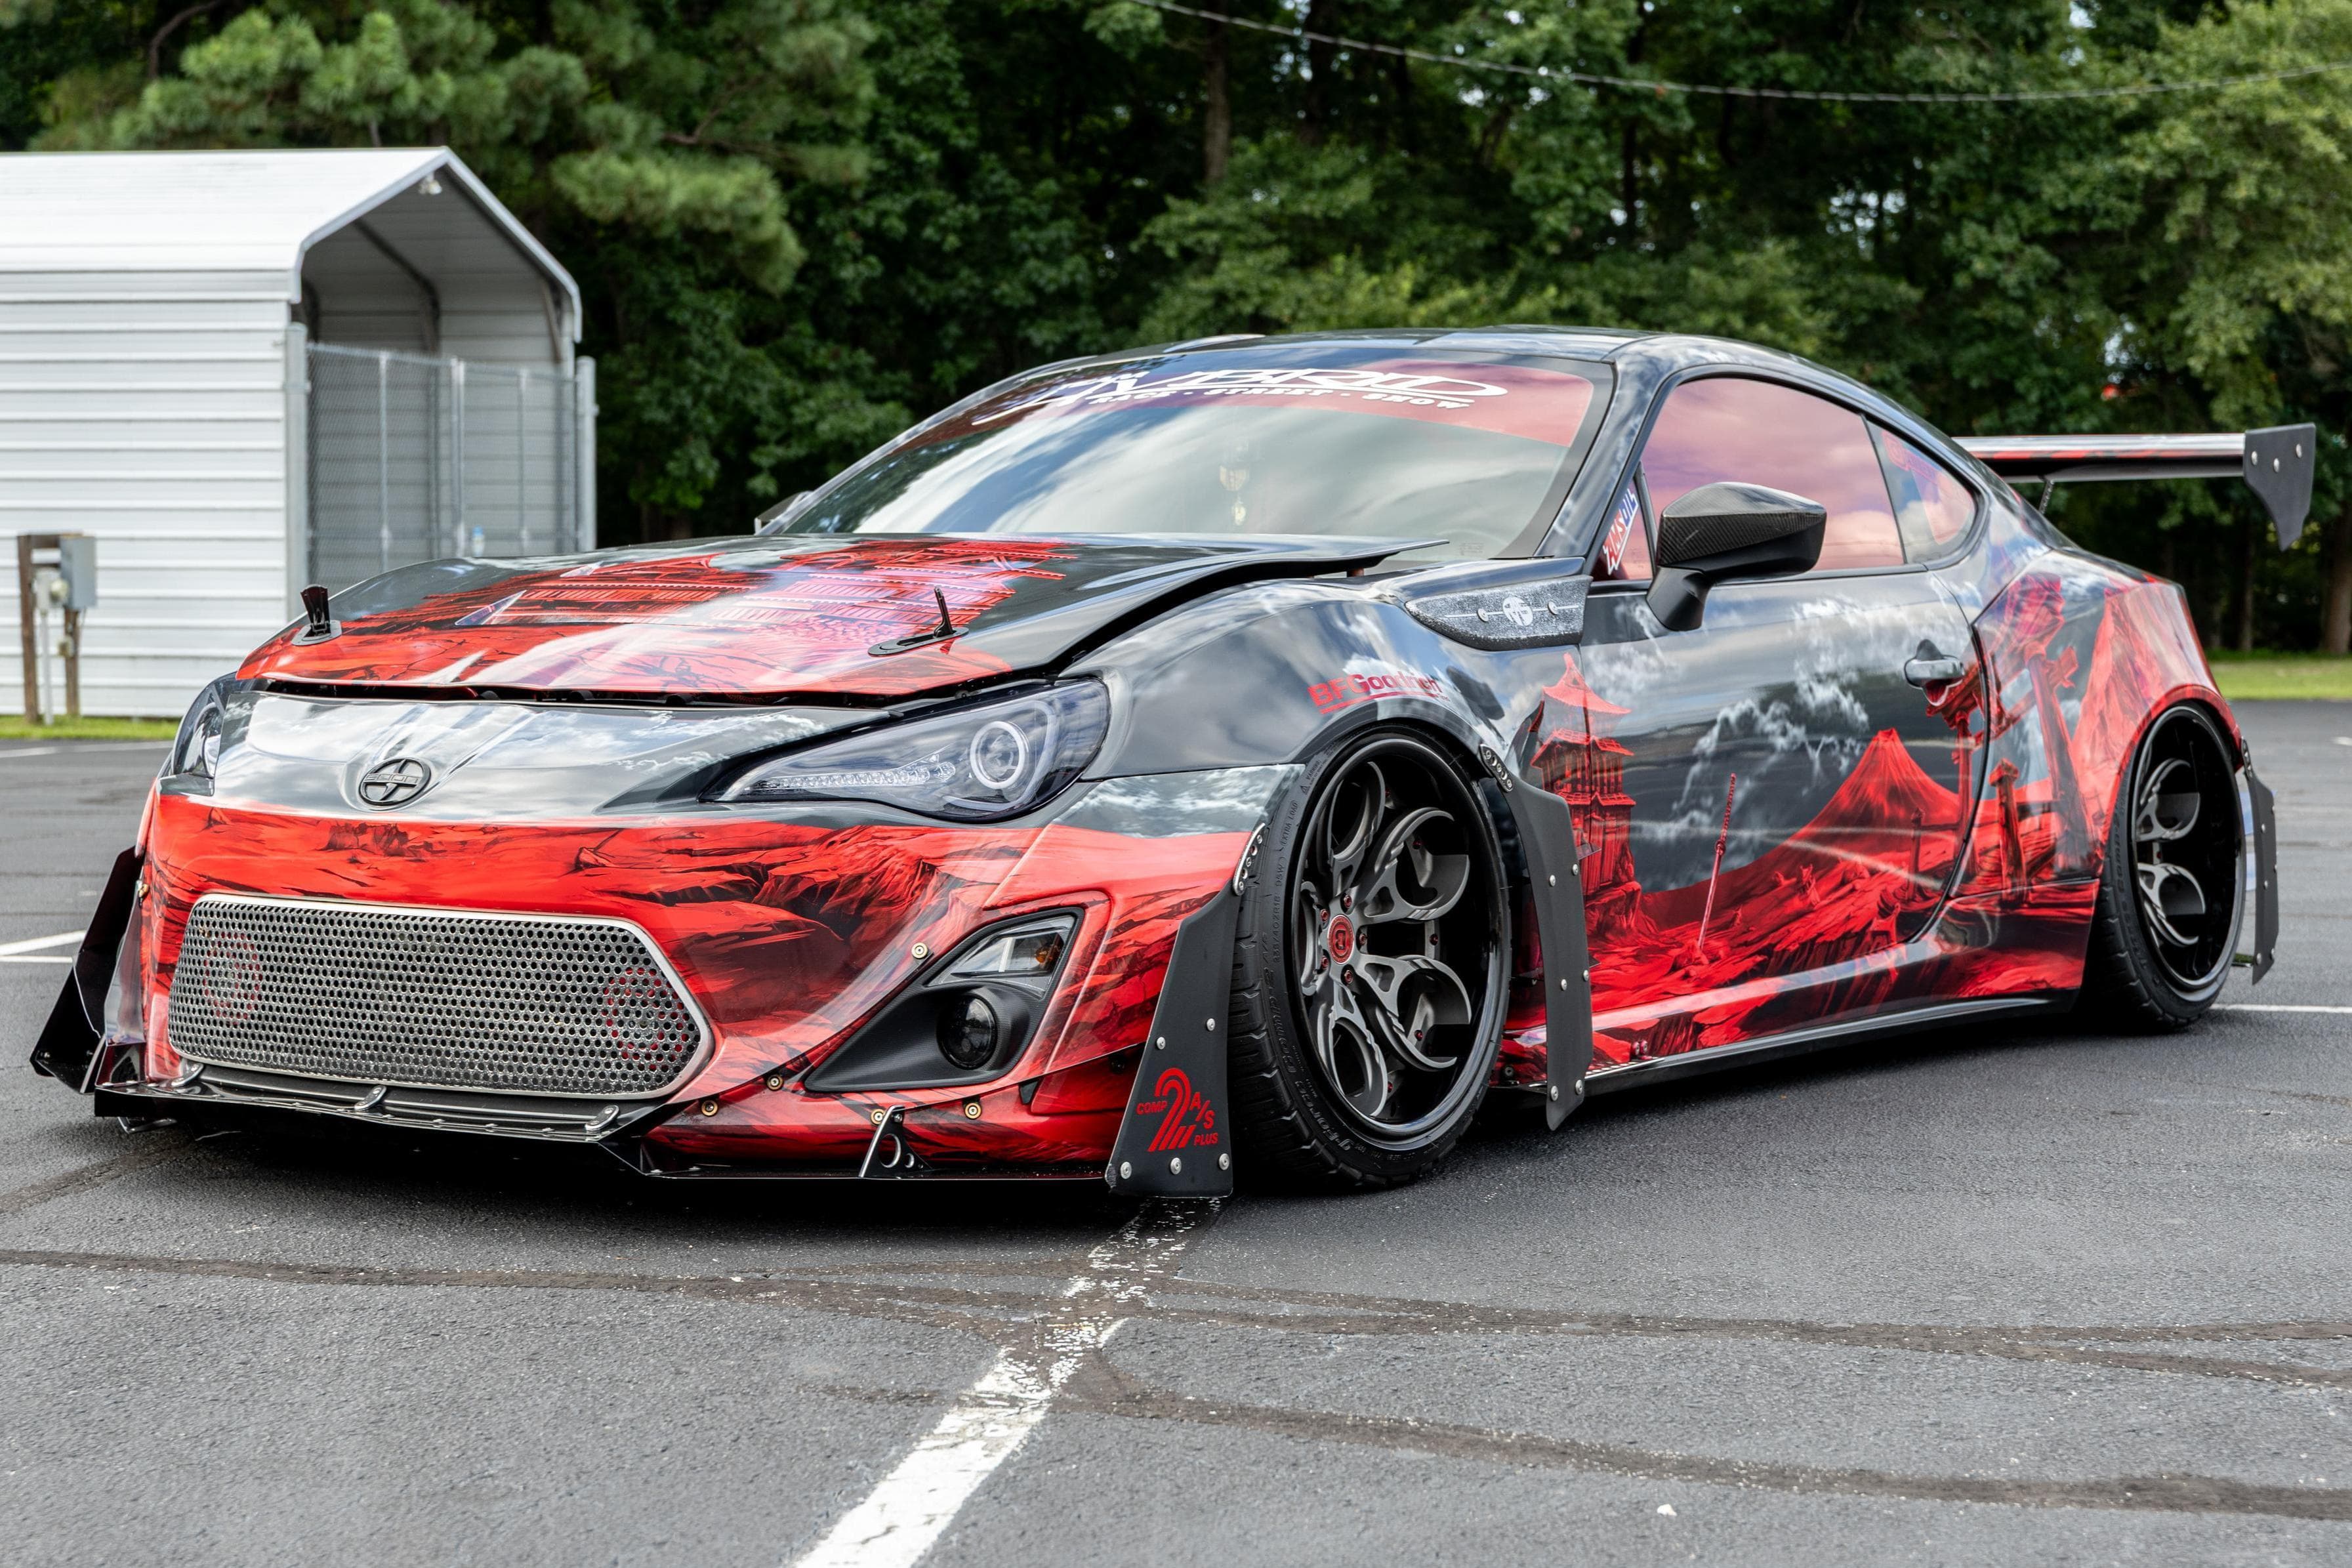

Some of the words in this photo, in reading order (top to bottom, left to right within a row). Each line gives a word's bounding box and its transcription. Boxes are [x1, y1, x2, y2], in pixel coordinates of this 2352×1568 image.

[1088, 391, 1177, 405] RACE
[1204, 388, 1332, 397] STREET
[1363, 393, 1470, 409] SHOW
[1308, 671, 1443, 707] BFGoodrich
[1137, 1101, 1168, 1115] COMP
[1148, 1068, 1196, 1152] 2
[1190, 1092, 1215, 1129] A/S
[1195, 1133, 1218, 1146] PLUS
